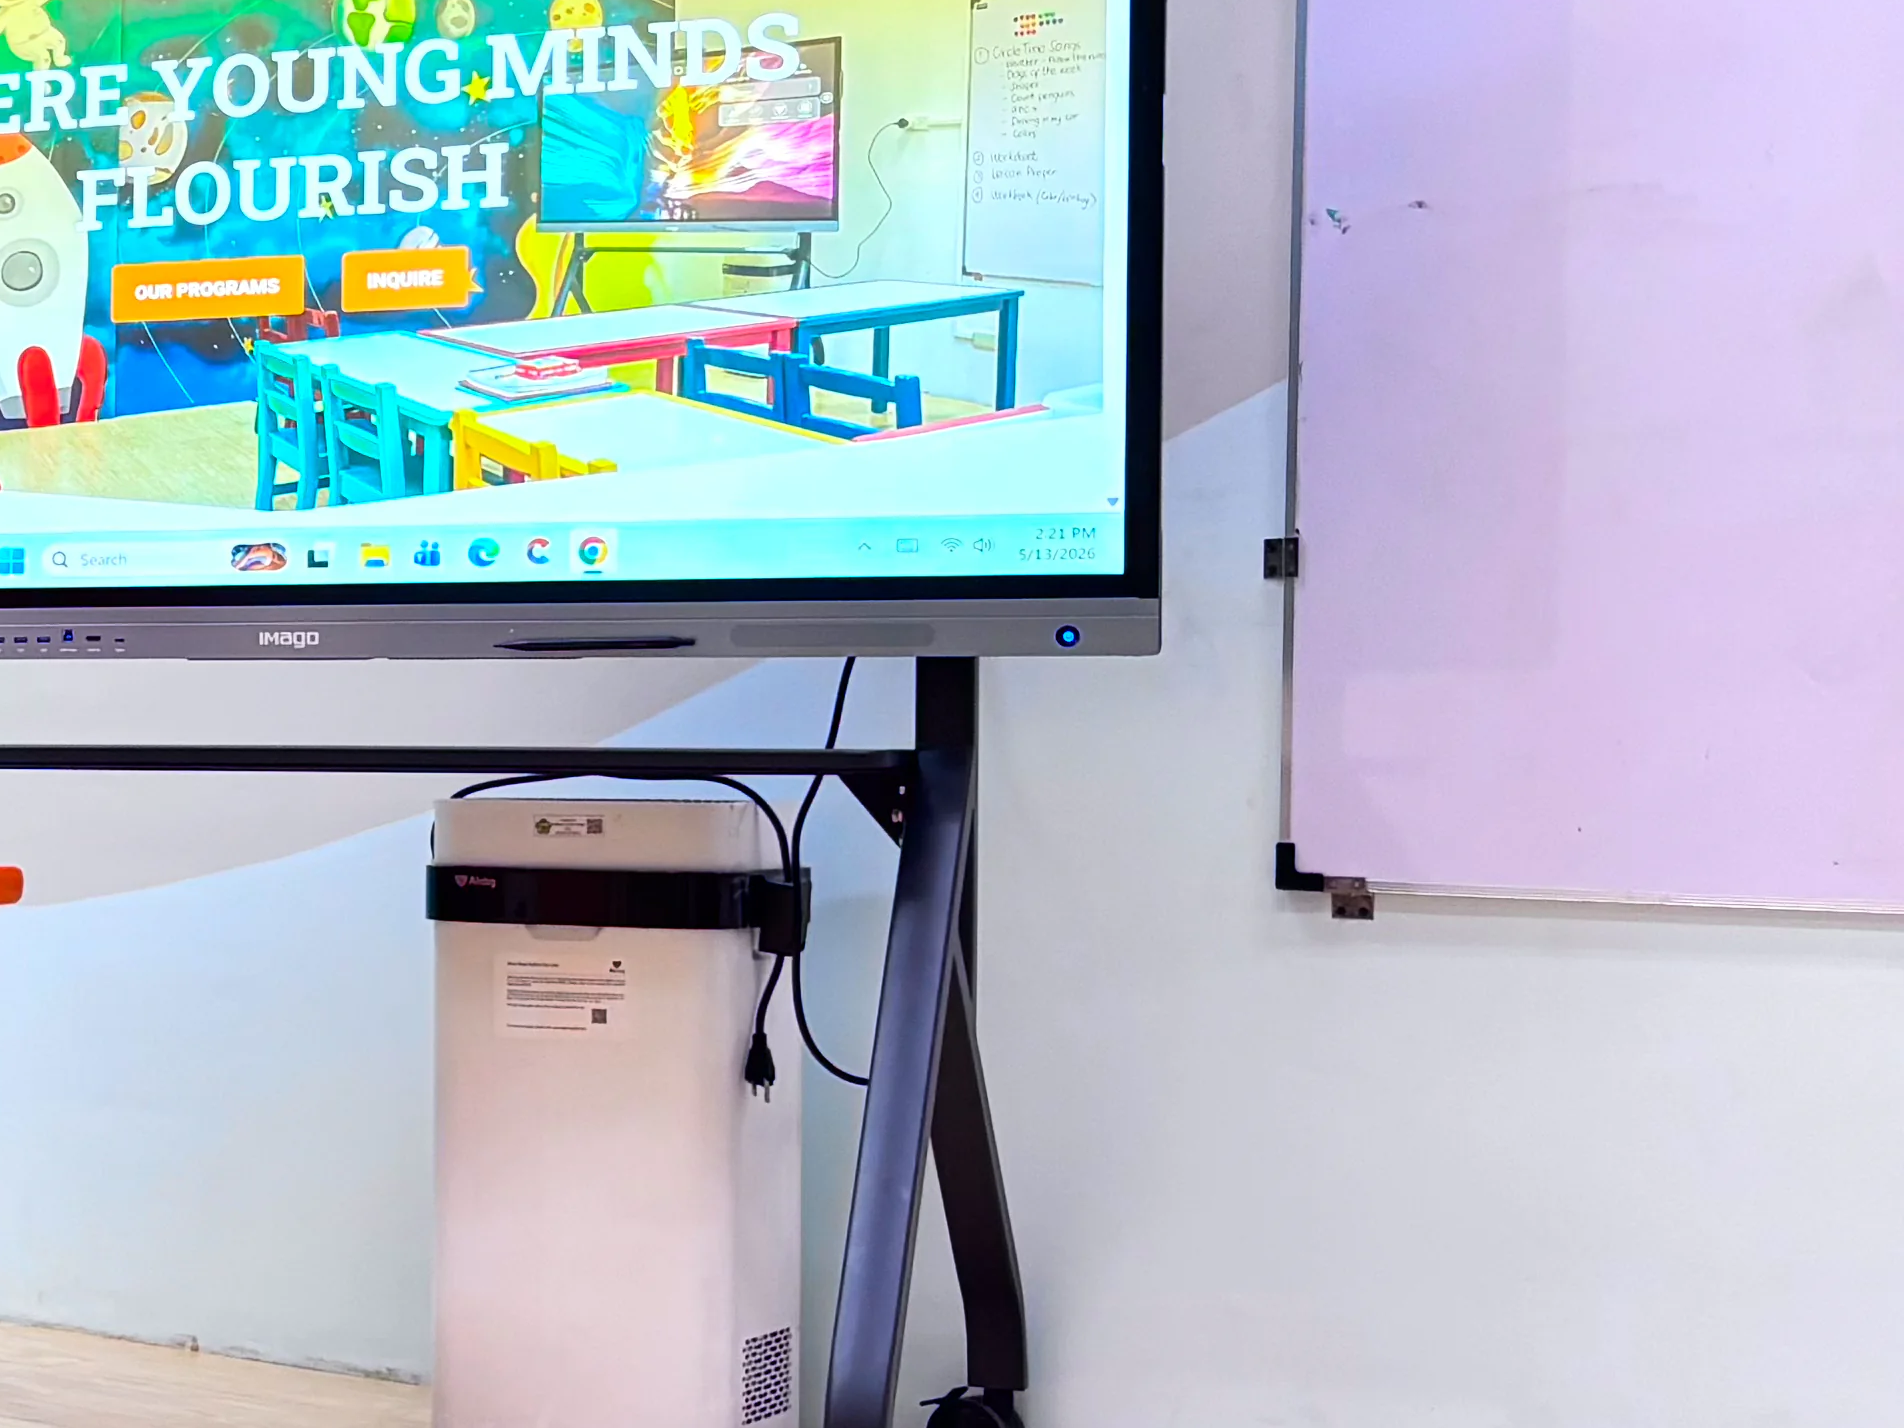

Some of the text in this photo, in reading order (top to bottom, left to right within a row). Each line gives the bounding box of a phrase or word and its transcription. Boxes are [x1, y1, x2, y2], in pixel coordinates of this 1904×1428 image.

[152, 35, 465, 123] YOUNG
[485, 11, 802, 100] MINDS
[77, 142, 510, 233] FLOURISH
[134, 278, 281, 301] OUR PROGRAMS
[366, 269, 445, 290] INQUIRE
[1035, 527, 1096, 540] 2:21 PM
[80, 553, 128, 568] Search
[1018, 548, 1096, 561] 5/13/2026
